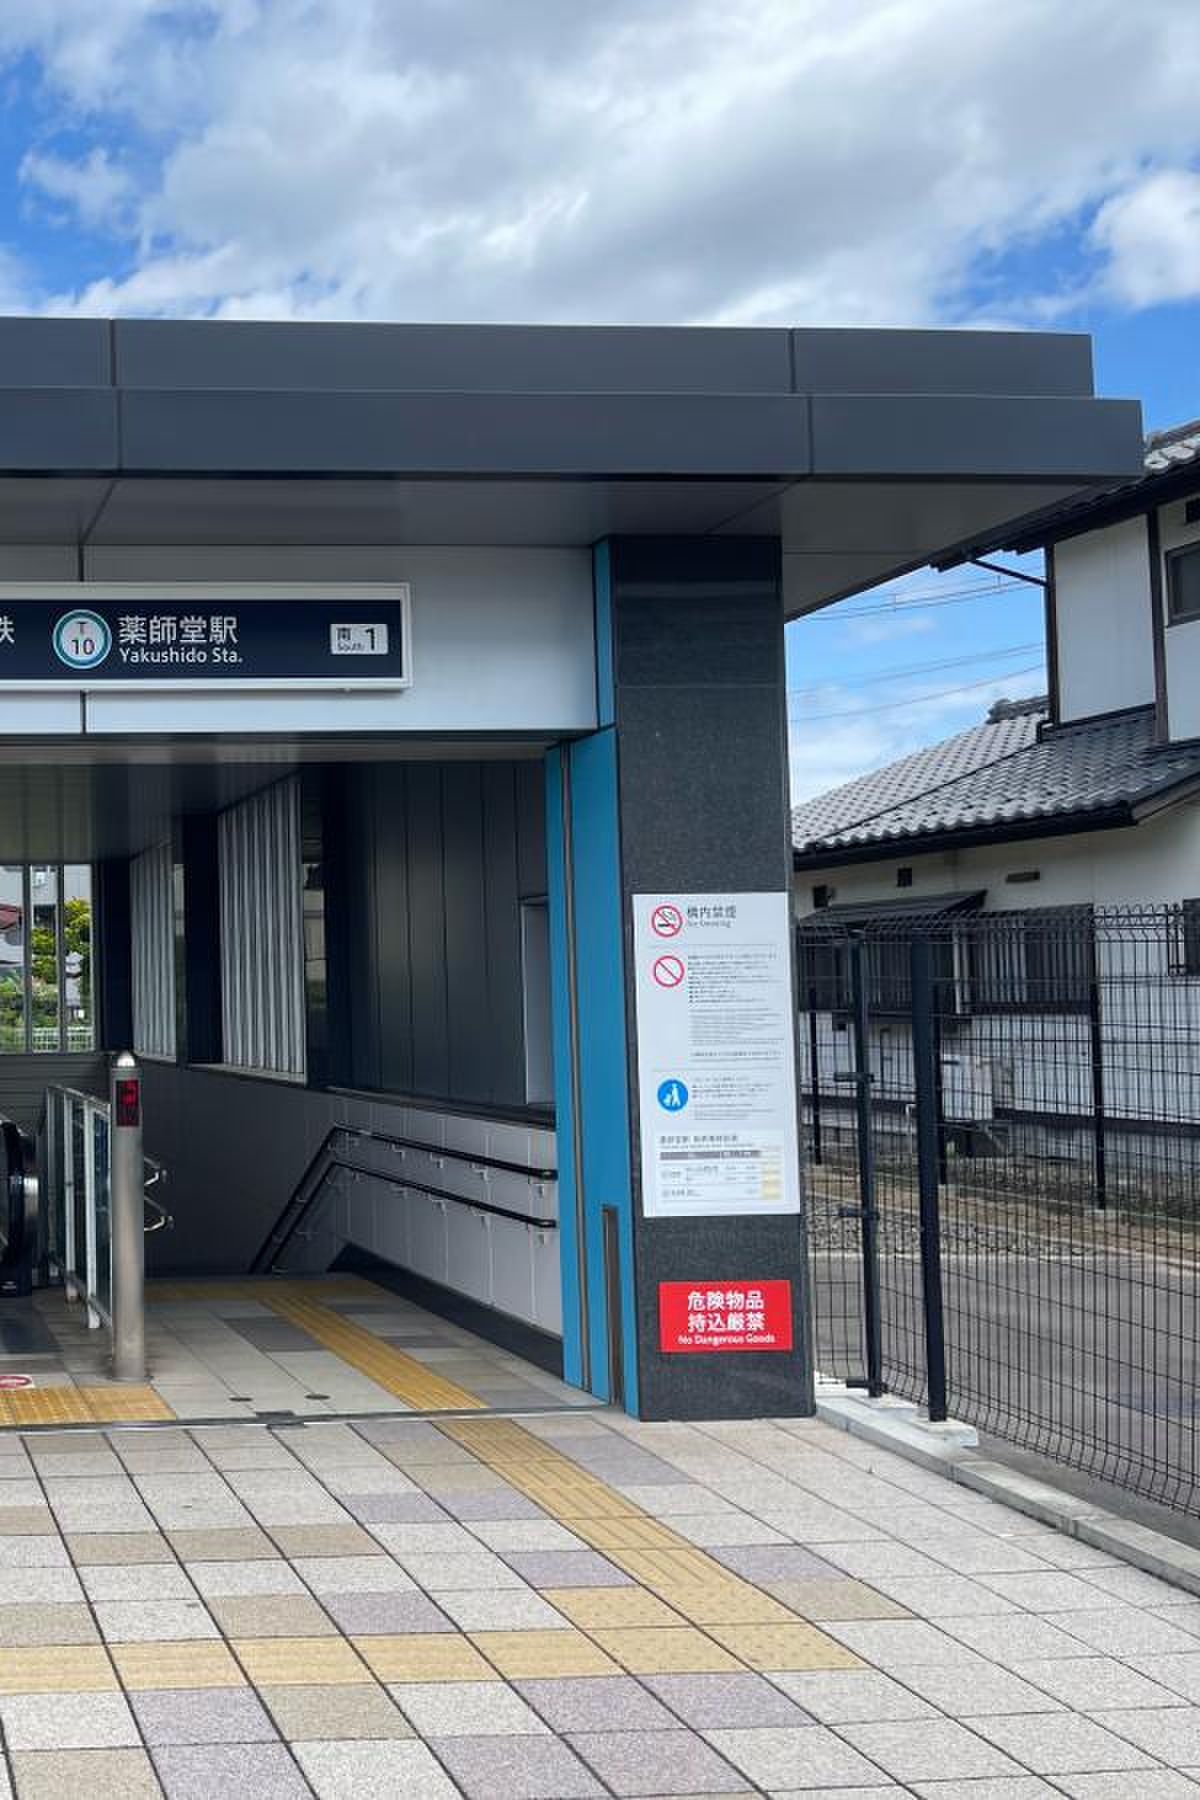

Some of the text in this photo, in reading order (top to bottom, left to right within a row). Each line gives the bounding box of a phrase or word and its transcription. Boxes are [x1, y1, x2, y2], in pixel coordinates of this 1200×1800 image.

[76, 622, 87, 635] T
[118, 615, 239, 645] 薬師堂駅
[72, 638, 96, 655] 10
[364, 627, 375, 651] 1
[119, 647, 244, 664] Yakushido Sta.
[687, 1290, 765, 1311] 危険物品
[687, 1312, 766, 1332] 持込厳禁
[677, 1335, 693, 1345] No
[745, 1332, 776, 1344] Goods
